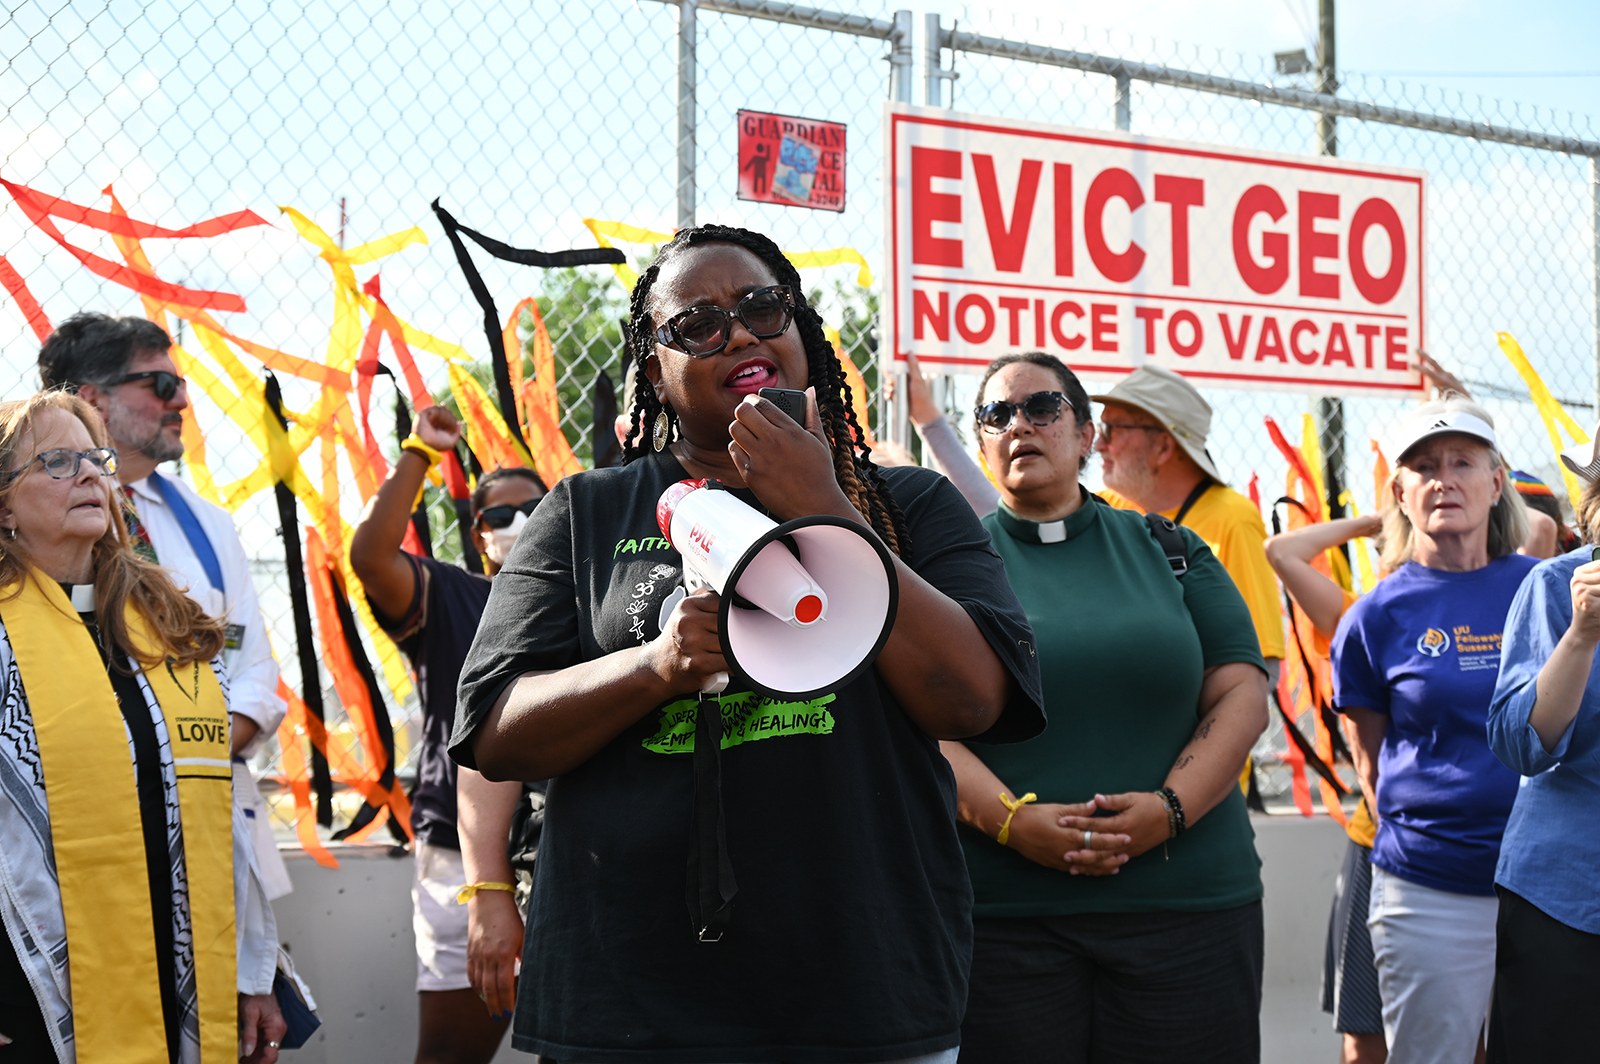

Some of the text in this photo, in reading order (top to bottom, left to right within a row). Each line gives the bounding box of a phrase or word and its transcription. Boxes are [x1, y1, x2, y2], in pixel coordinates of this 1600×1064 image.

[743, 116, 841, 148] GUARDIAN
[912, 146, 1406, 304] EVICT GEO
[913, 290, 1408, 371] NOTICE TO VACATE
[690, 522, 716, 553] PYLE
[1453, 625, 1471, 635] UU
[1457, 643, 1494, 653] Sussex
[177, 723, 225, 744] LOVE
[737, 723, 746, 737] &
[750, 711, 826, 732] HEALING!
